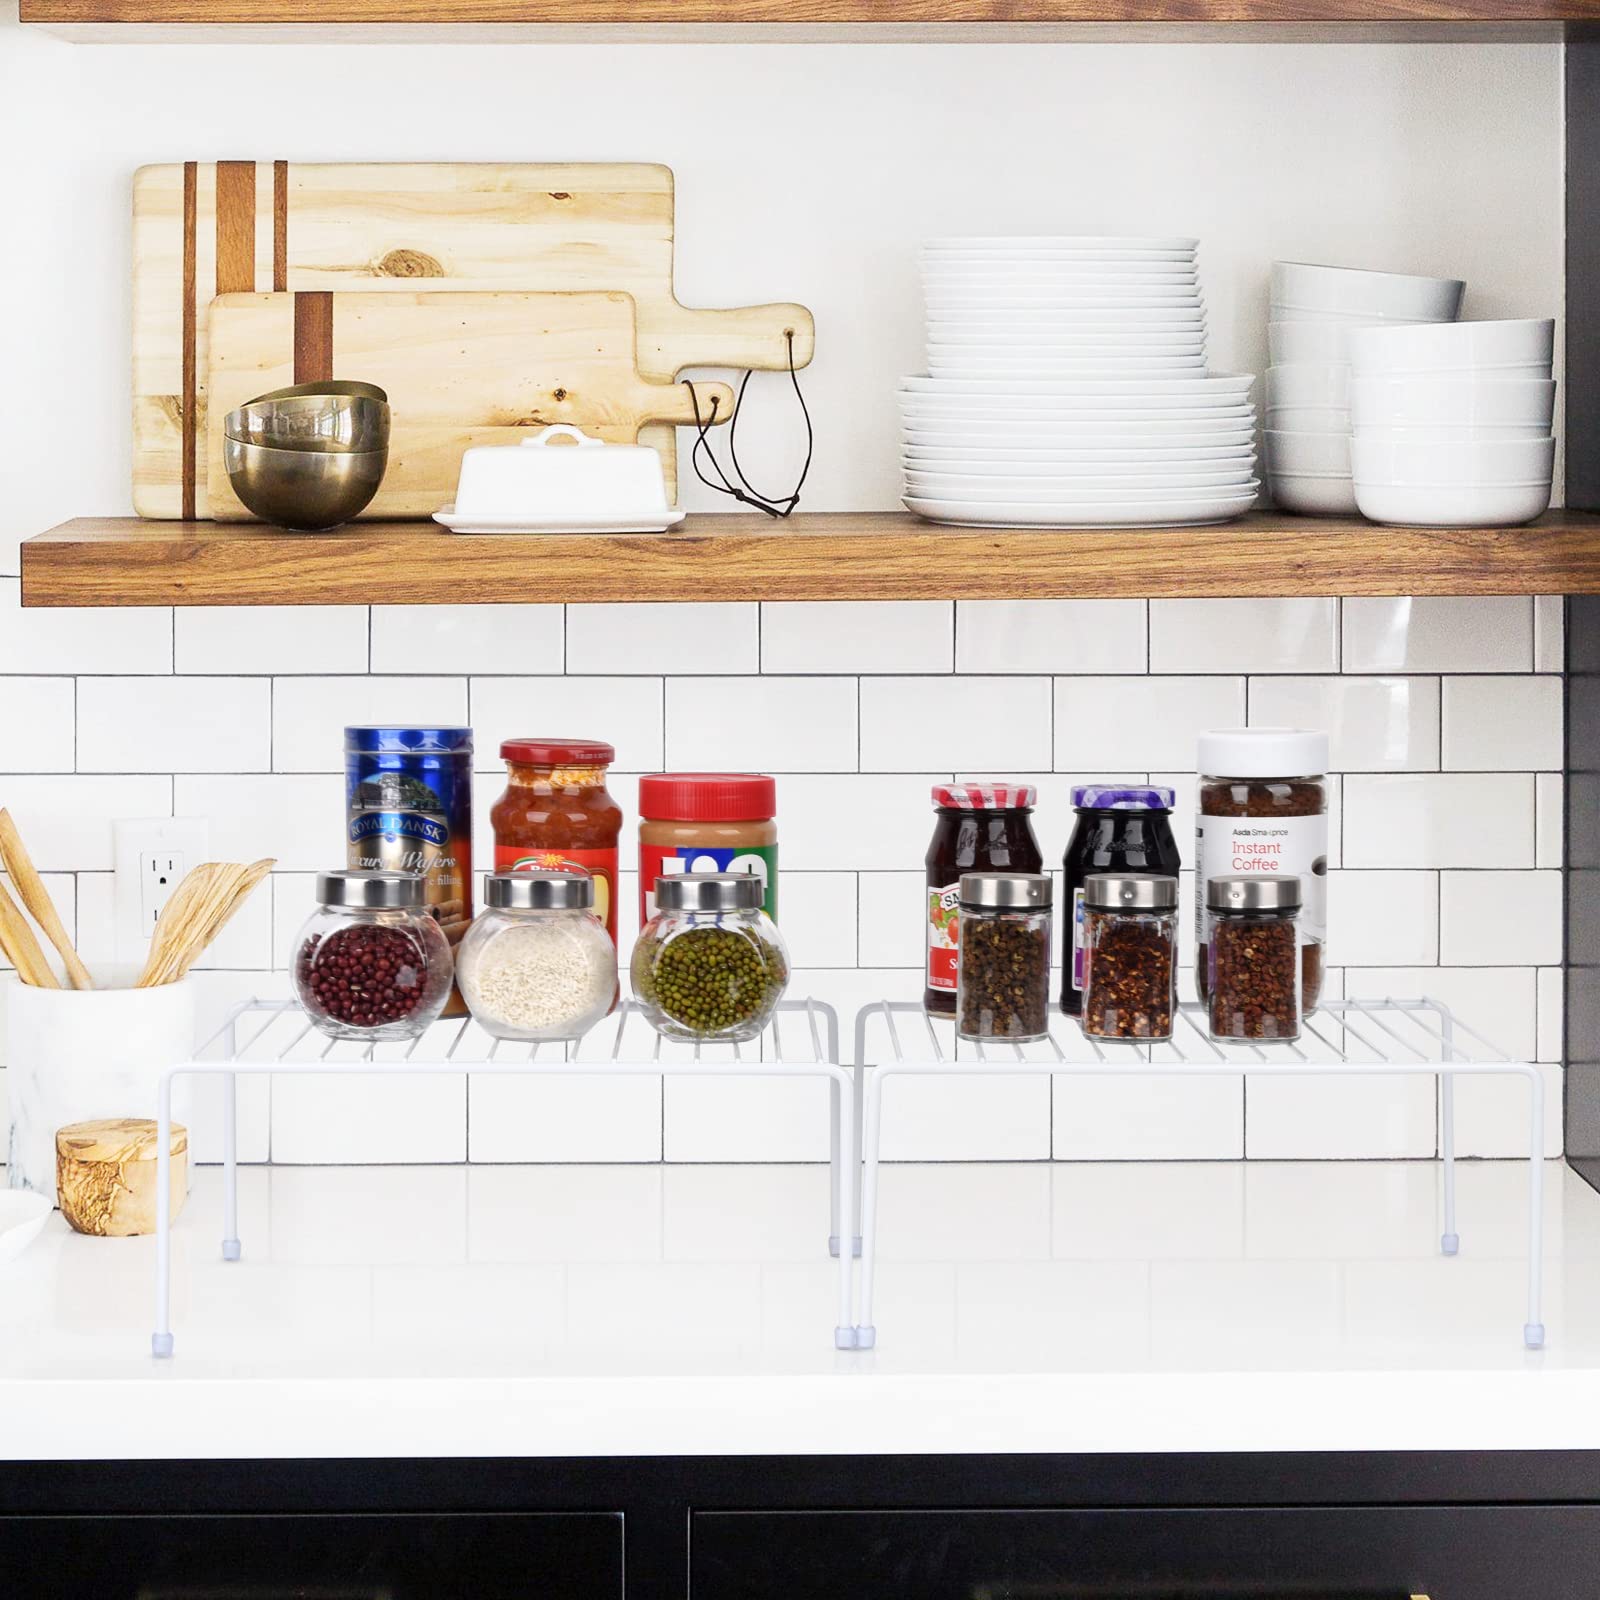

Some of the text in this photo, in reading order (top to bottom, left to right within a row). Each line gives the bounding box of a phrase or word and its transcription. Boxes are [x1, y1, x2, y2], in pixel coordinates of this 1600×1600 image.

[351, 818, 441, 840] ROYAL DANSK
[1232, 841, 1281, 854] Instant
[401, 851, 456, 875] Wafers
[1232, 857, 1279, 871] Coffee
